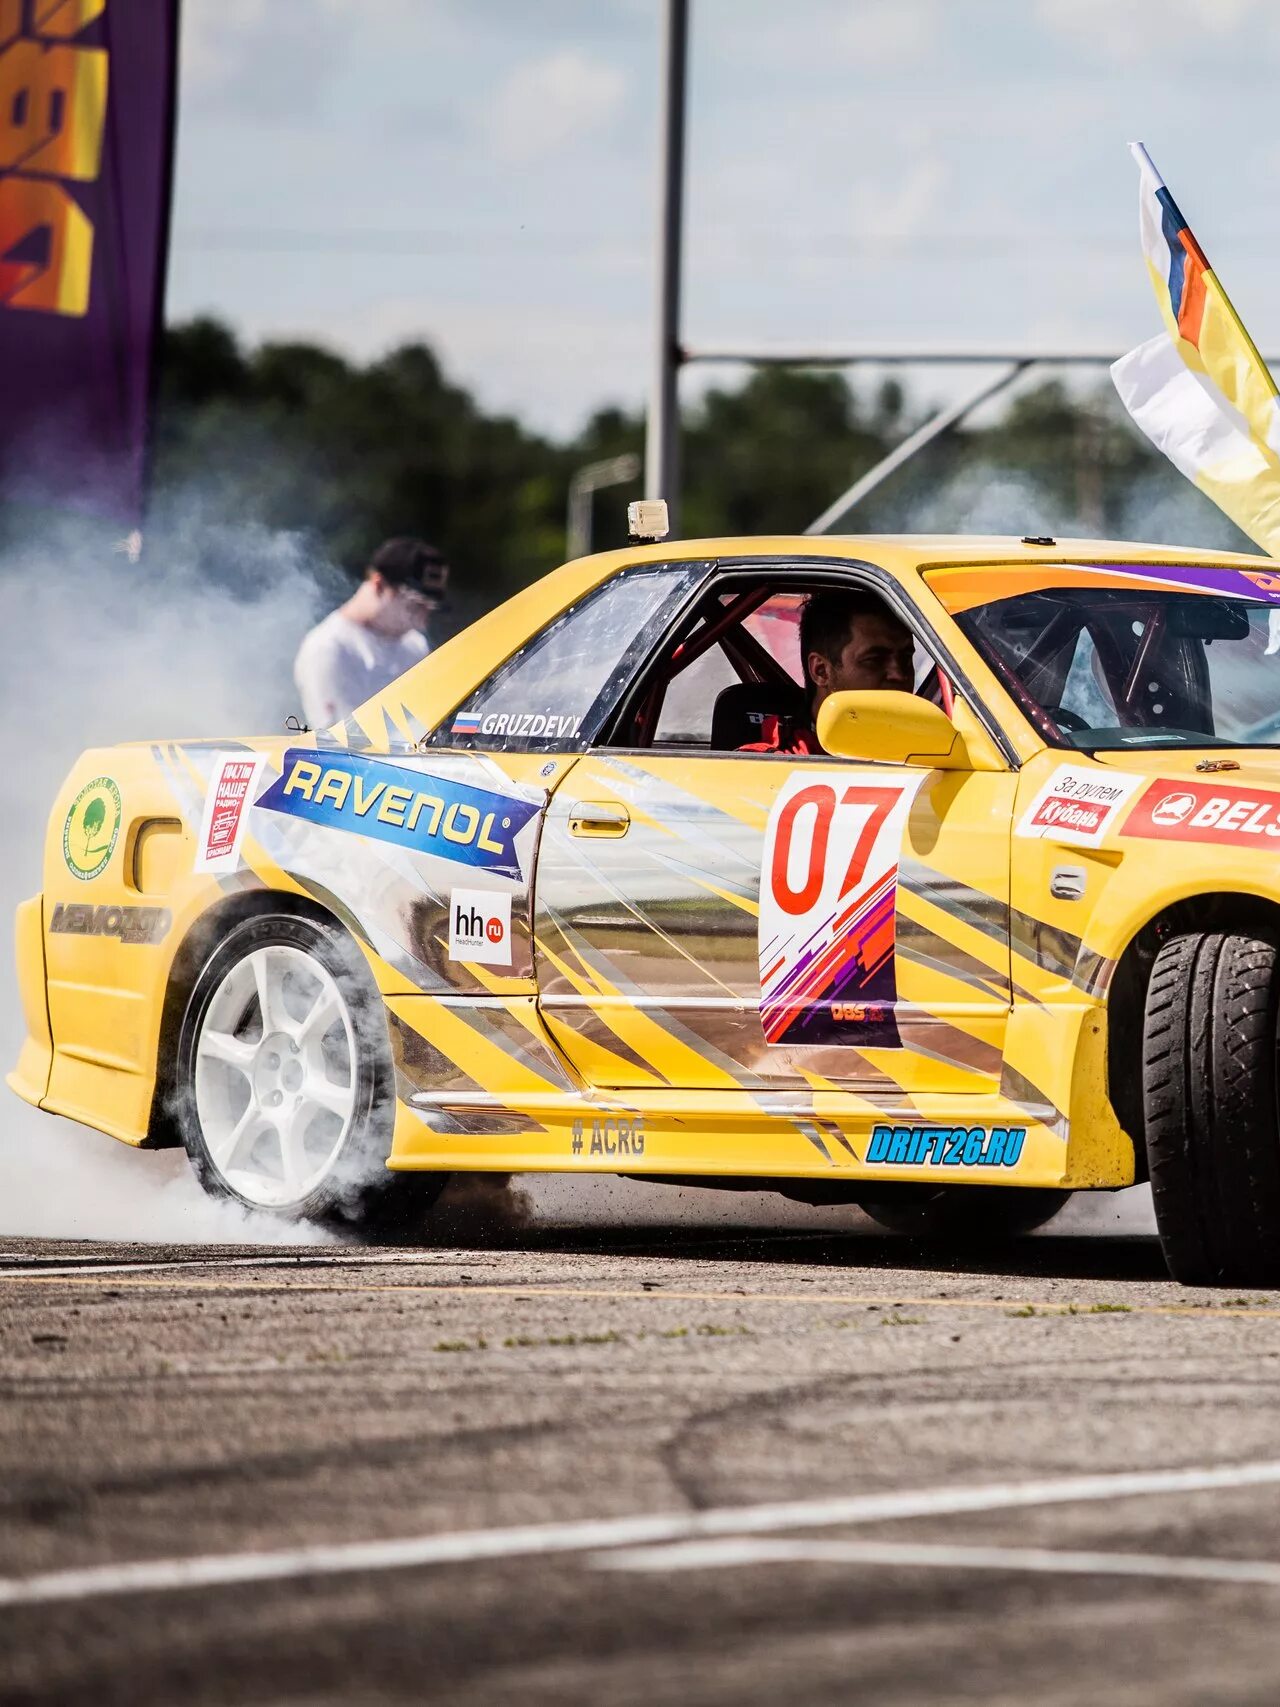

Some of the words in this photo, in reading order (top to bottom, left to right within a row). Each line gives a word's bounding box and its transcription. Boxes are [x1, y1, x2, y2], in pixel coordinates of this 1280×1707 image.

[481, 713, 572, 738] GRUZDEV
[218, 782, 247, 798] НАШЕ
[1055, 776, 1077, 793] За
[1072, 783, 1123, 800] рулем
[216, 799, 237, 809] РАДИО
[1039, 800, 1099, 828] Кубань
[771, 784, 904, 915] 07
[456, 905, 483, 937] hh
[831, 1003, 866, 1021] DBS
[590, 1118, 644, 1155] ACRG
[866, 1126, 1026, 1166] DRIFT26.RU
